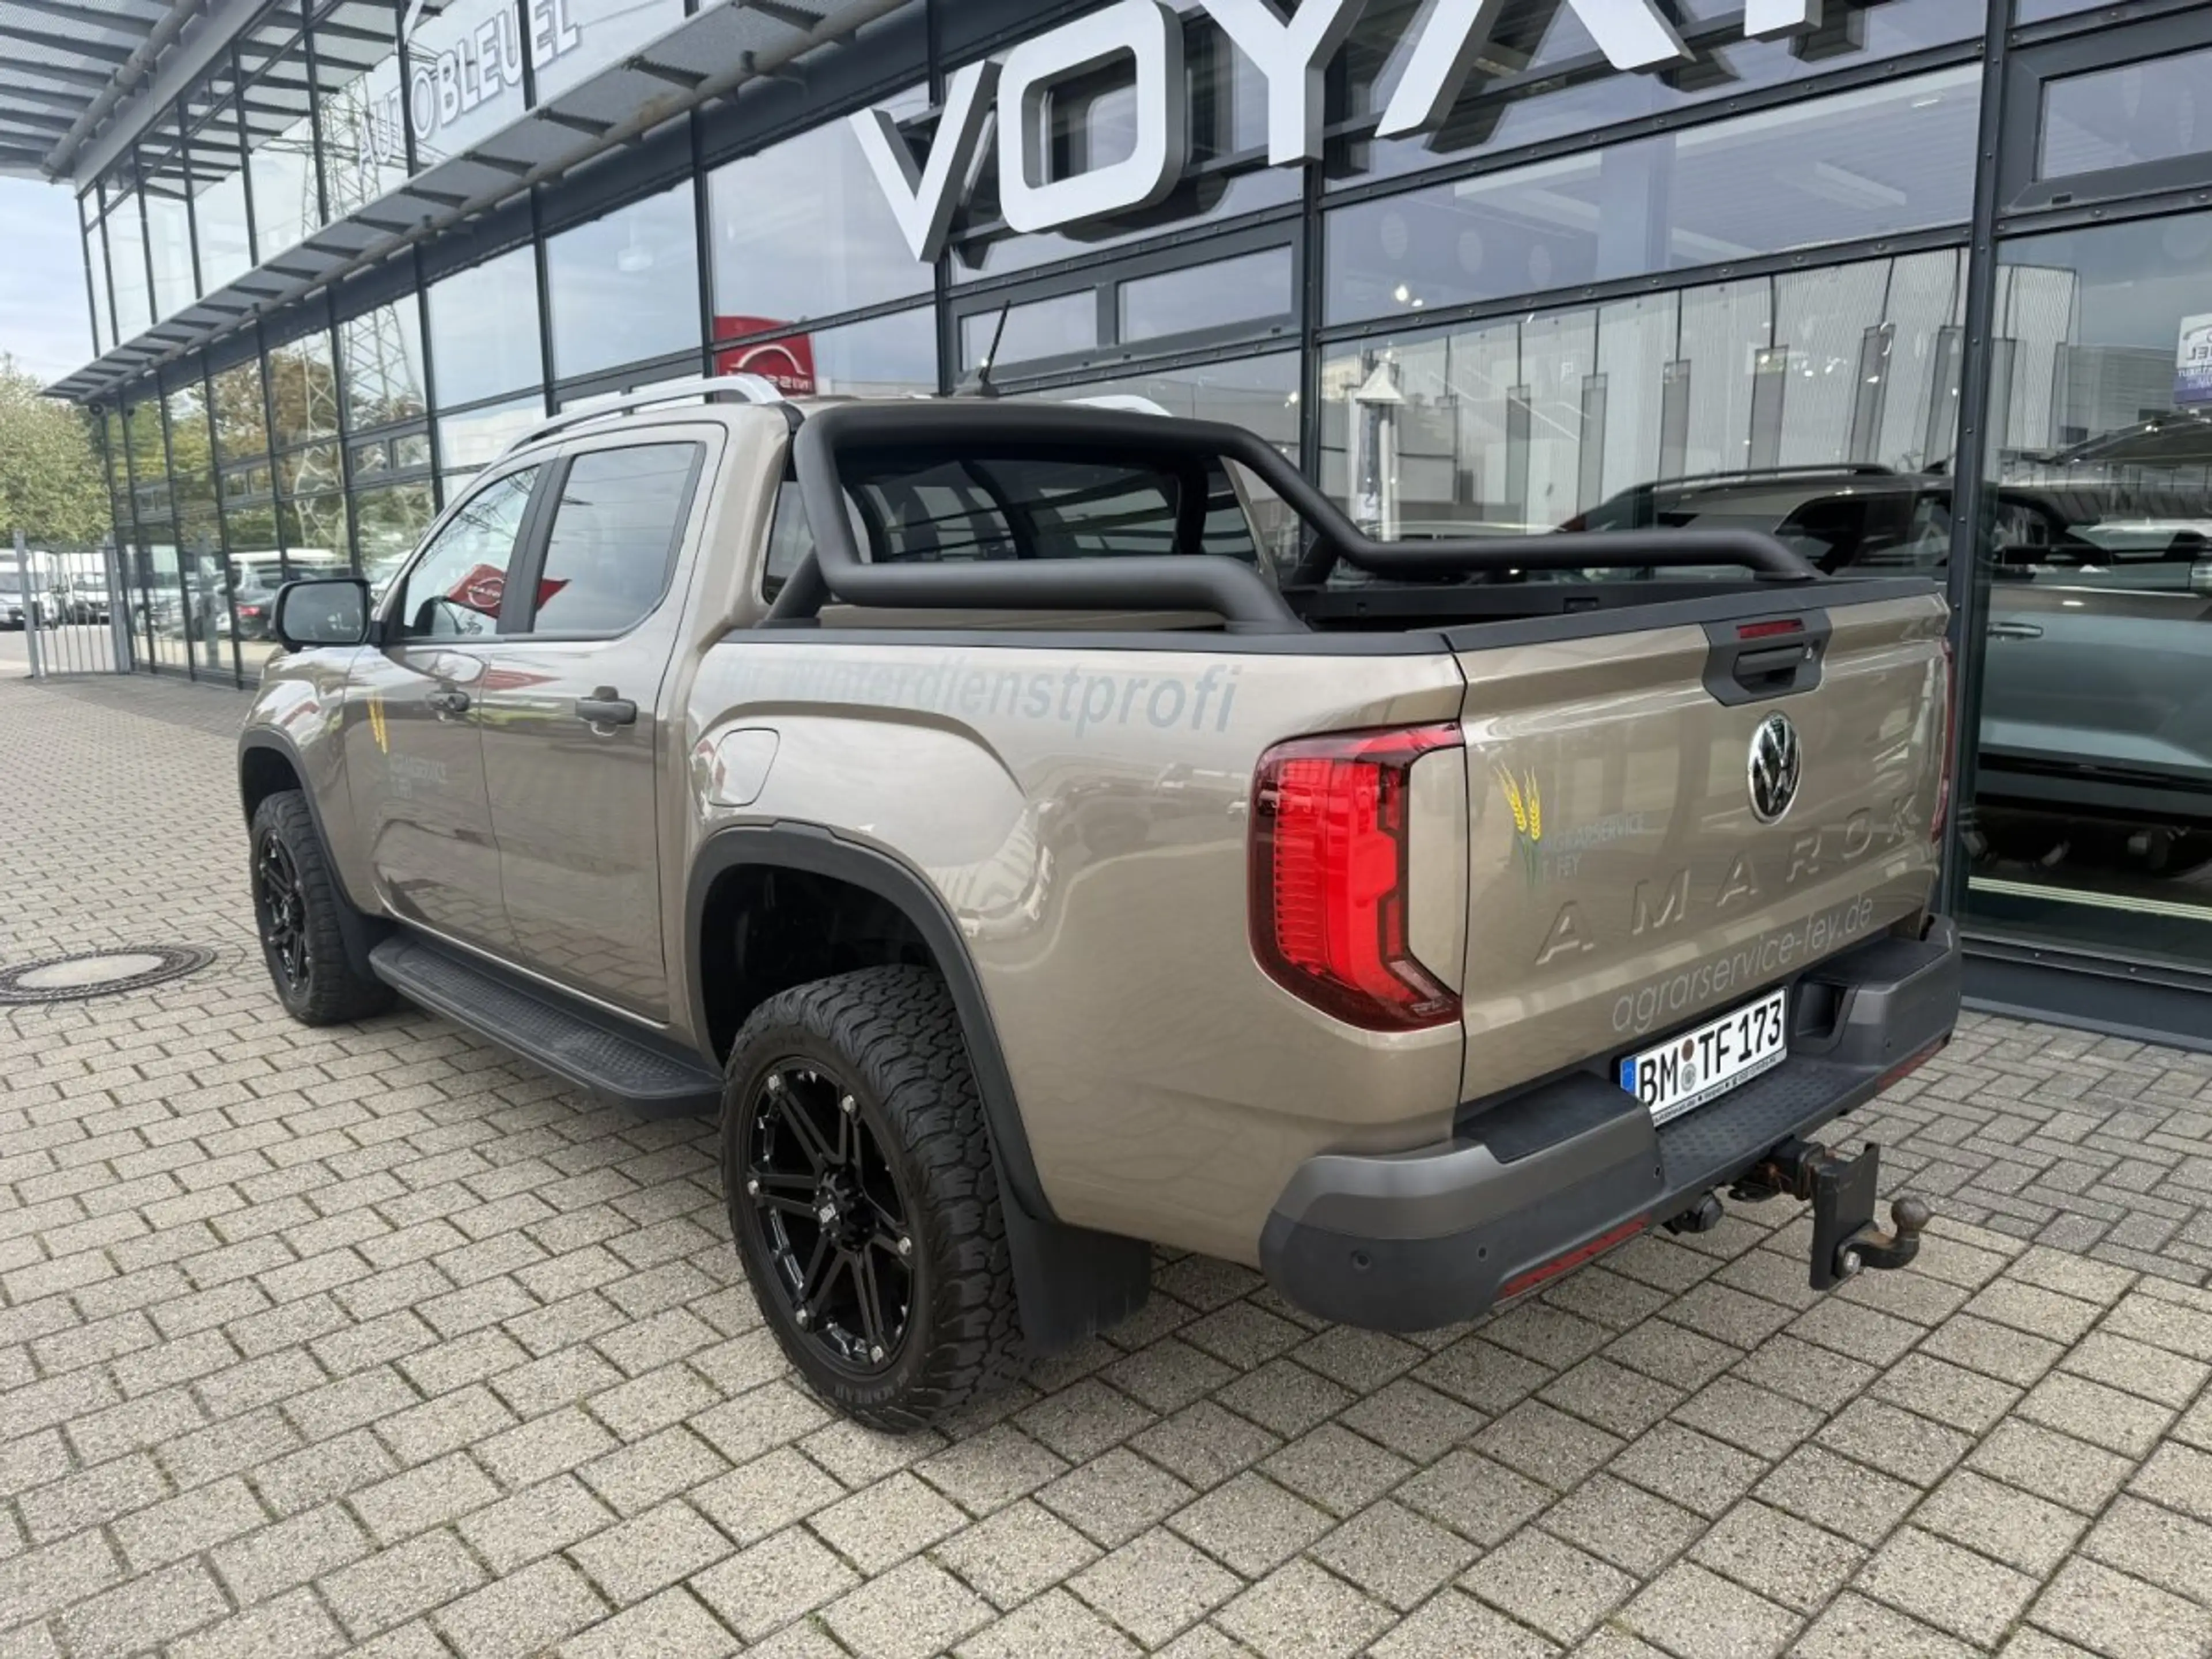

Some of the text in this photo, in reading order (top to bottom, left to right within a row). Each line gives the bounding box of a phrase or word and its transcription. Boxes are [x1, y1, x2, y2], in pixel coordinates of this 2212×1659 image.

[1533, 792, 1921, 966] AMAROK
[1612, 893, 1873, 1035] agrarservice-fey.de
[1639, 1047, 1679, 1107] BM
[1698, 1021, 1732, 1081] TF
[1738, 998, 1782, 1063] 173
